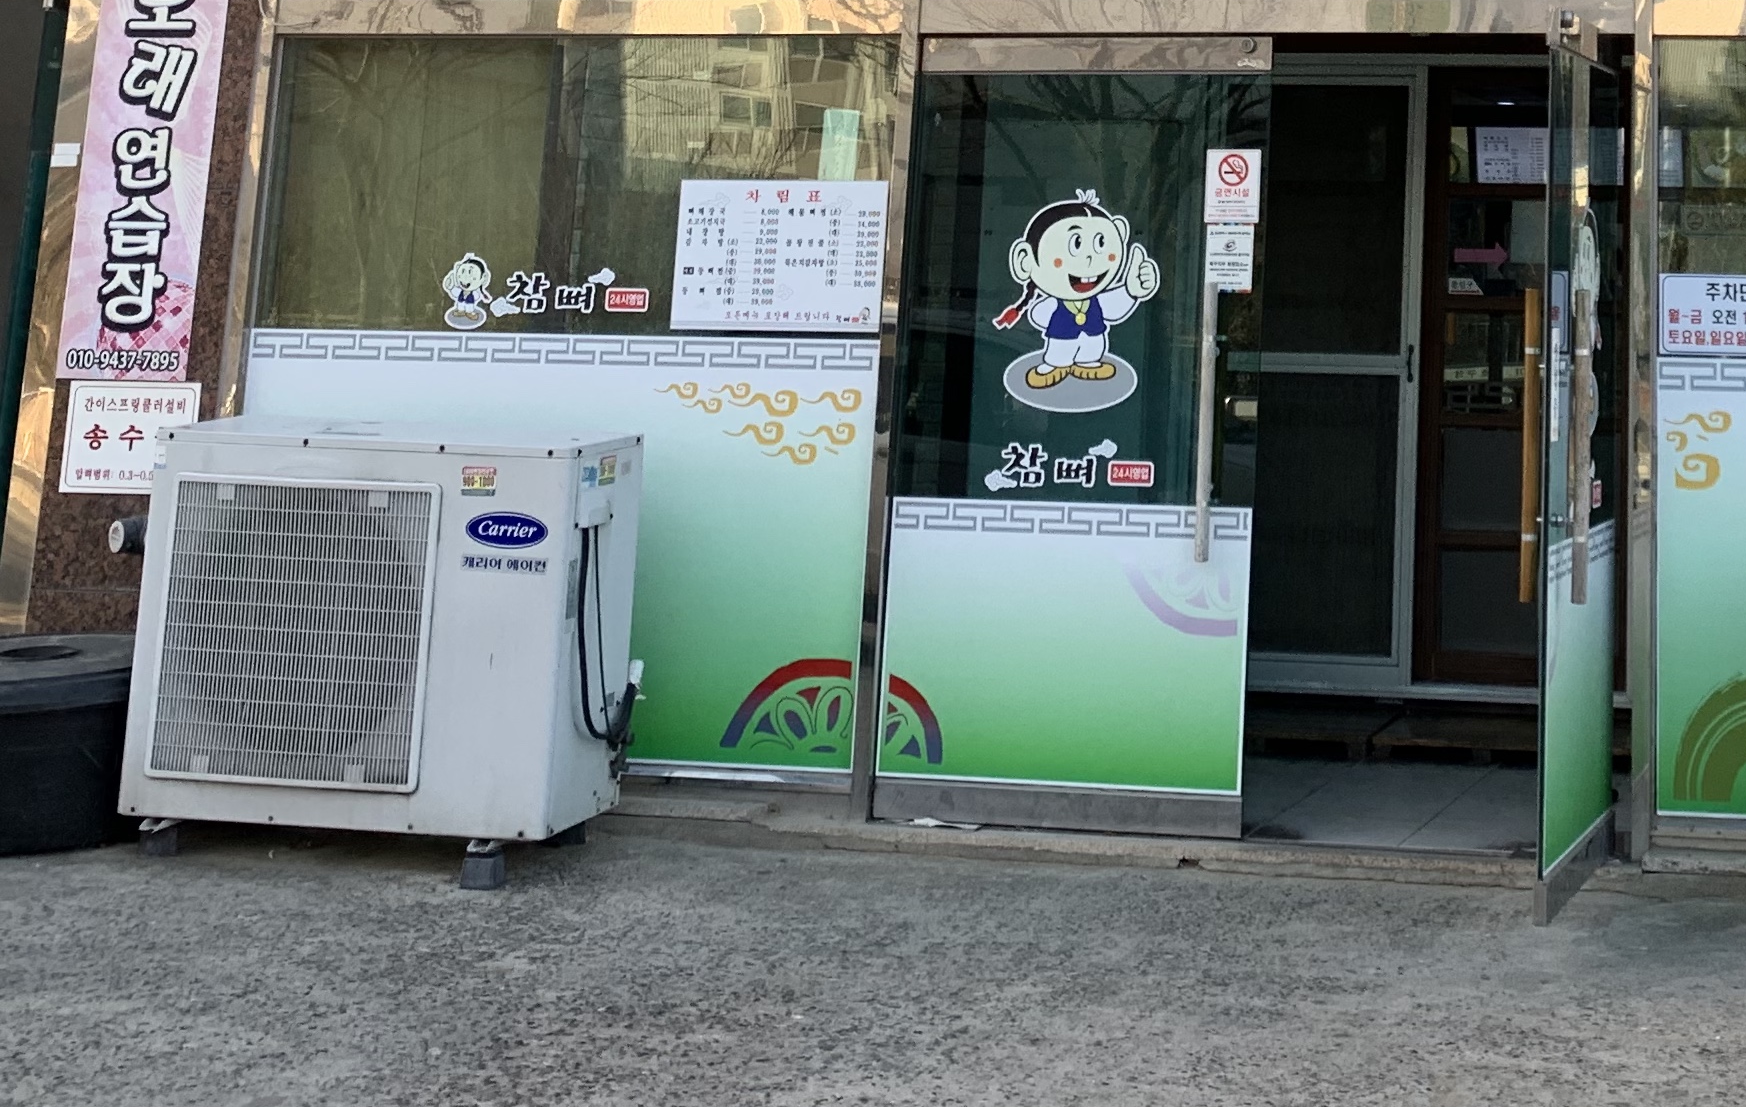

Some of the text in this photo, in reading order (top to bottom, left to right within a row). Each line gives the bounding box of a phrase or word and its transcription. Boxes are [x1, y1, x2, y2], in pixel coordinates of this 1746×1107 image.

[506, 271, 596, 313] 참뼈
[1712, 309, 1737, 326] 오전
[66, 348, 179, 371] 010-9437-7895
[83, 423, 158, 452] 송수
[1001, 442, 1097, 488] 참뼈
[478, 520, 538, 539] Carrier
[462, 555, 501, 570] 캐리어
